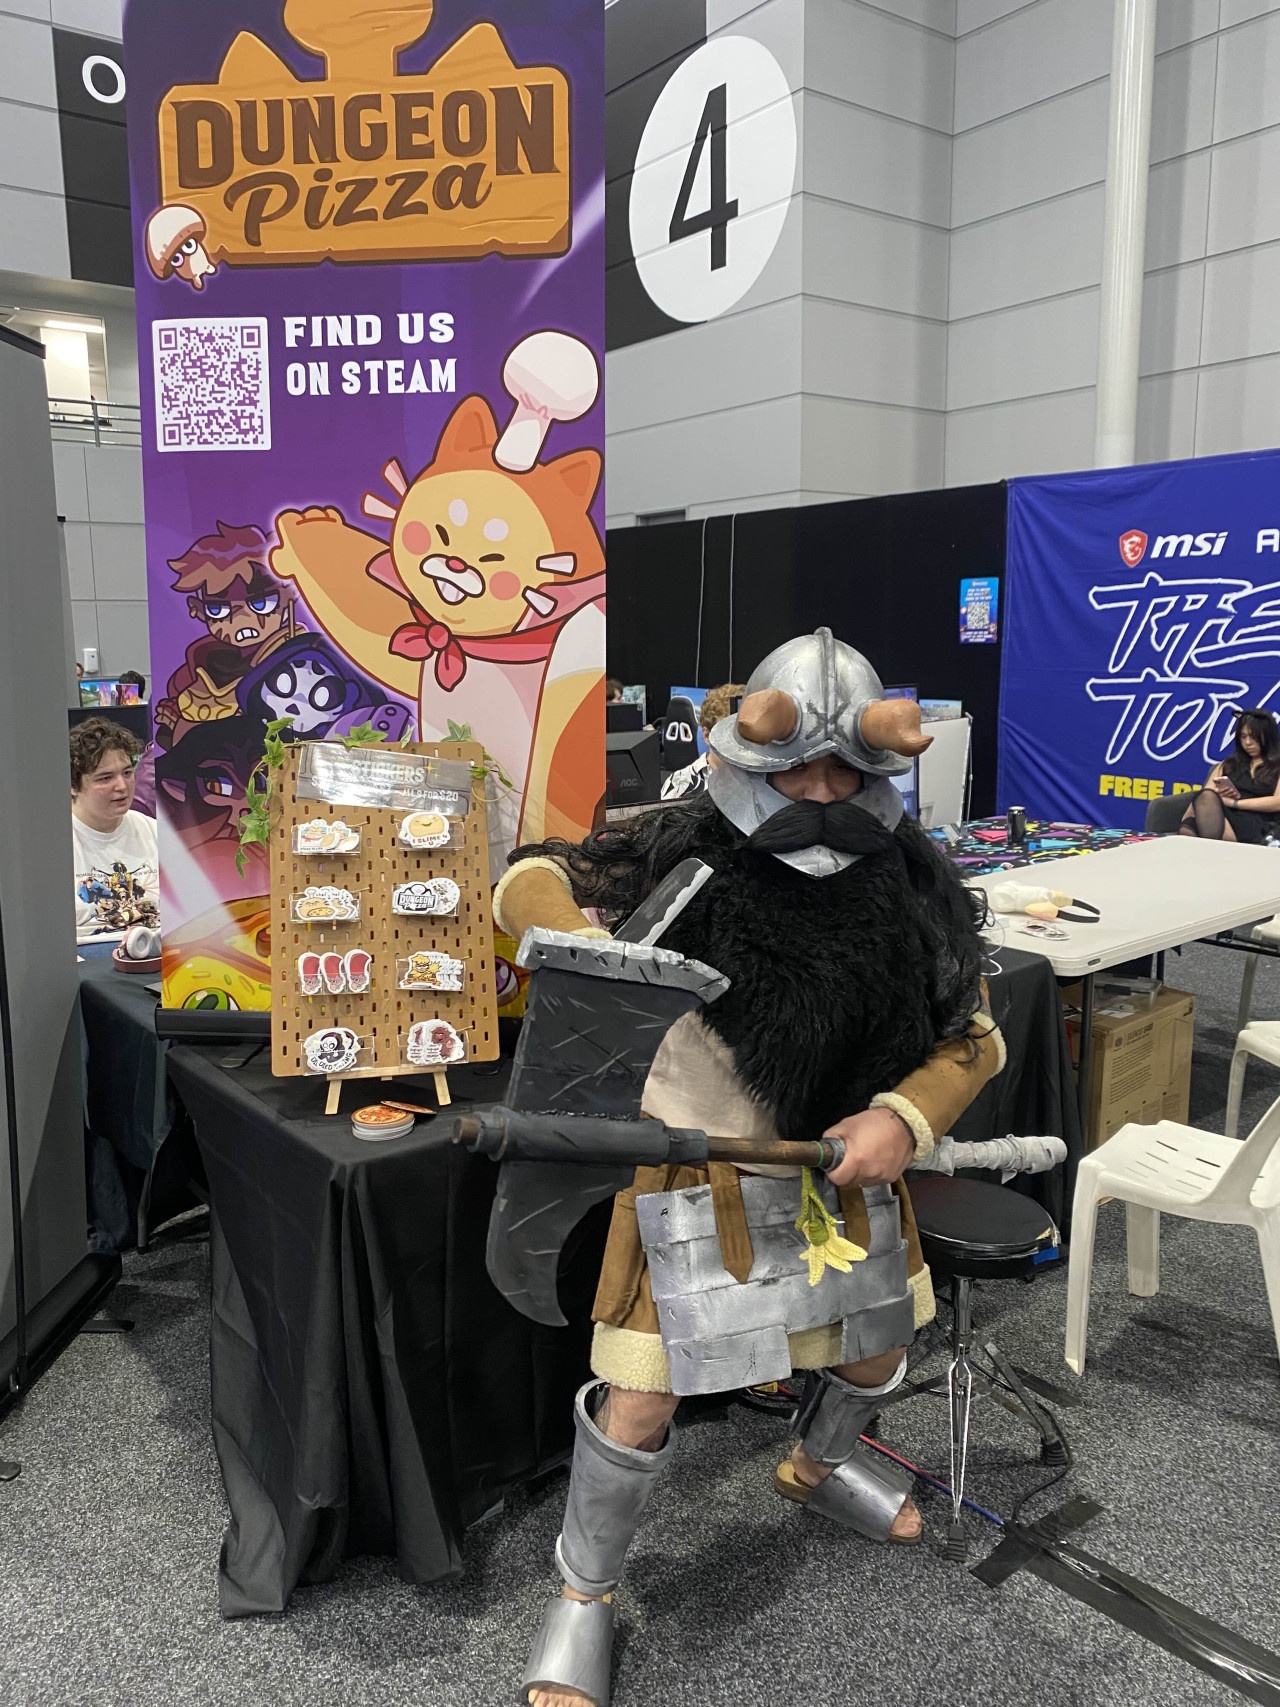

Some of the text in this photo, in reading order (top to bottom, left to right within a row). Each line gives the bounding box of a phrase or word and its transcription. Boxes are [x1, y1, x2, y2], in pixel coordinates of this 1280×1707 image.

[170, 83, 562, 190] DUNGEON
[669, 82, 739, 271] 4
[223, 162, 494, 247] Pizza
[282, 312, 455, 348] FIND US
[286, 358, 458, 396] ON STEAM
[1150, 531, 1229, 559] msi
[1099, 774, 1165, 801] FREE
